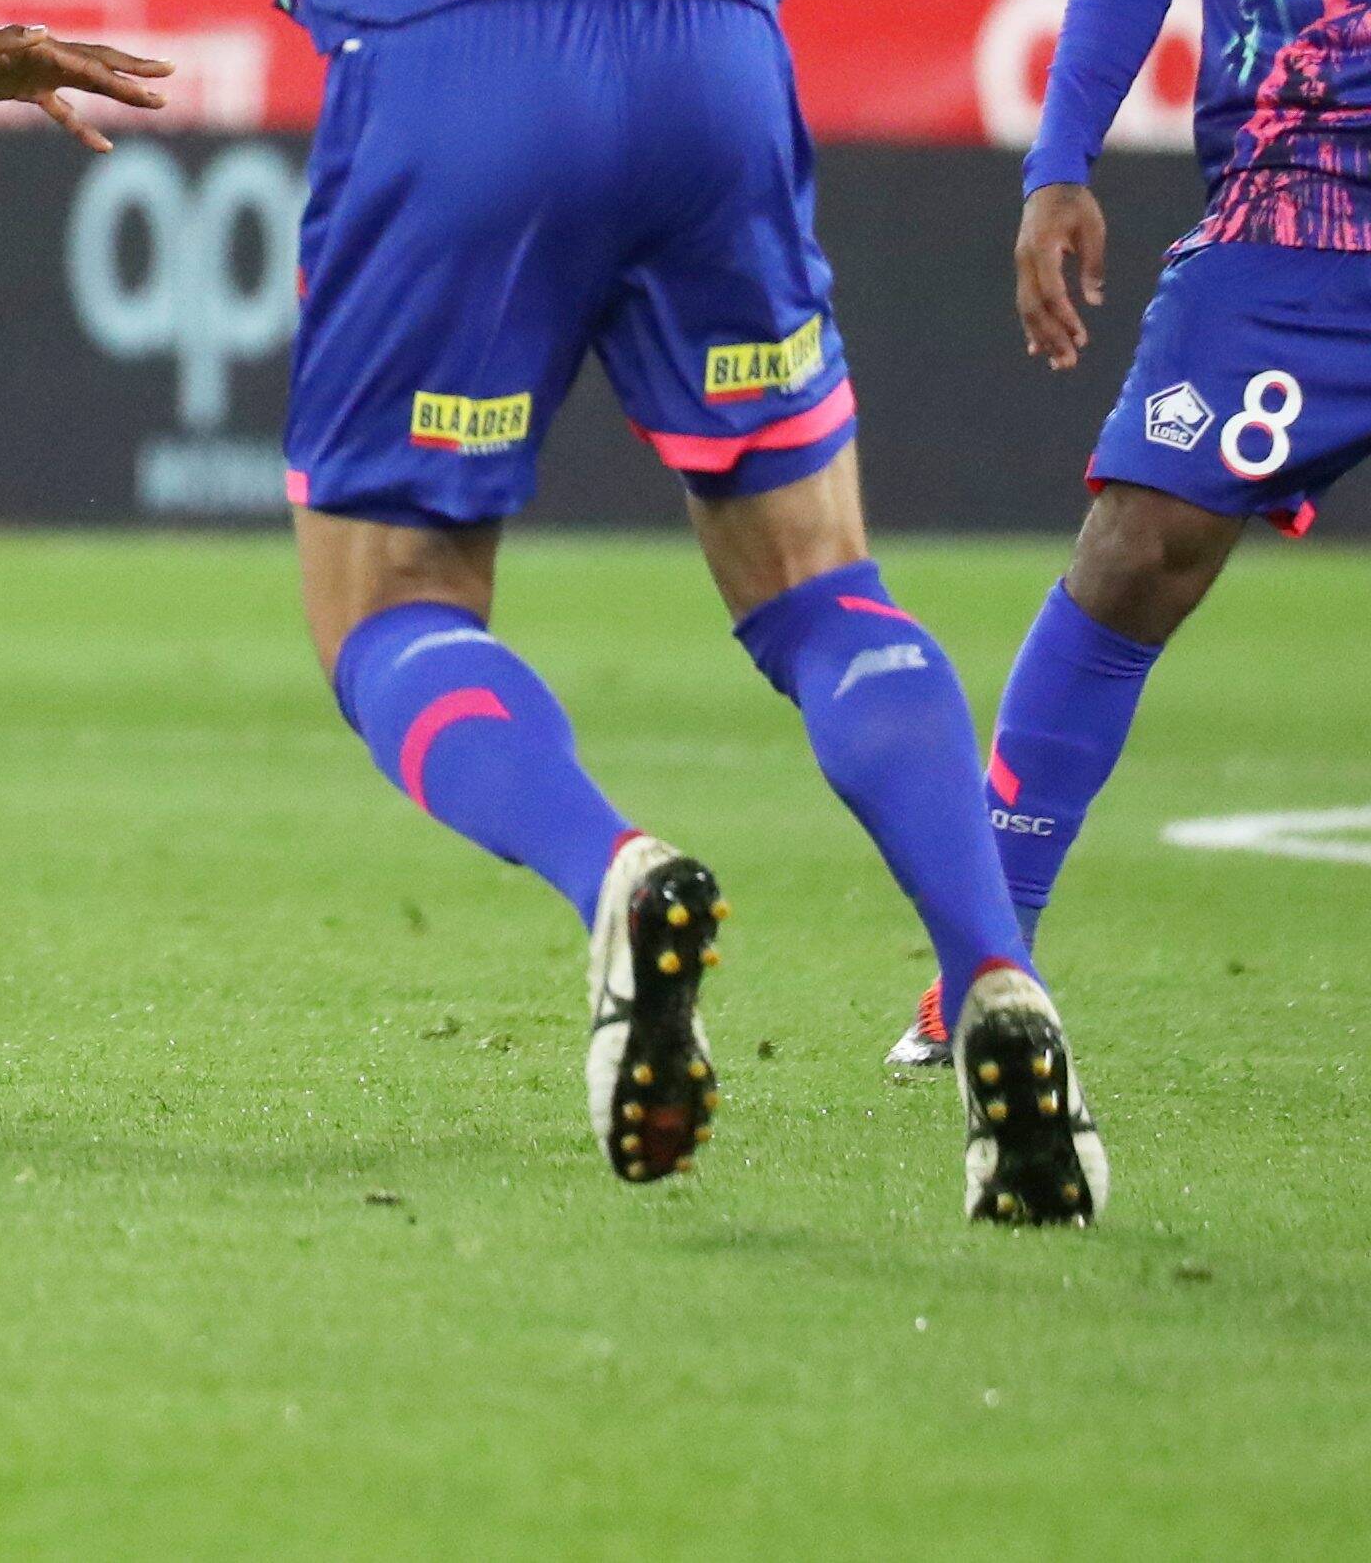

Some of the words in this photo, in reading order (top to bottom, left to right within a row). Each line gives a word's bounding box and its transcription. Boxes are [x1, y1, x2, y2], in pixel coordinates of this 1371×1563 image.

[1152, 424, 1189, 445] LOSC
[1219, 369, 1303, 481] 8
[990, 808, 1056, 837] OSC
